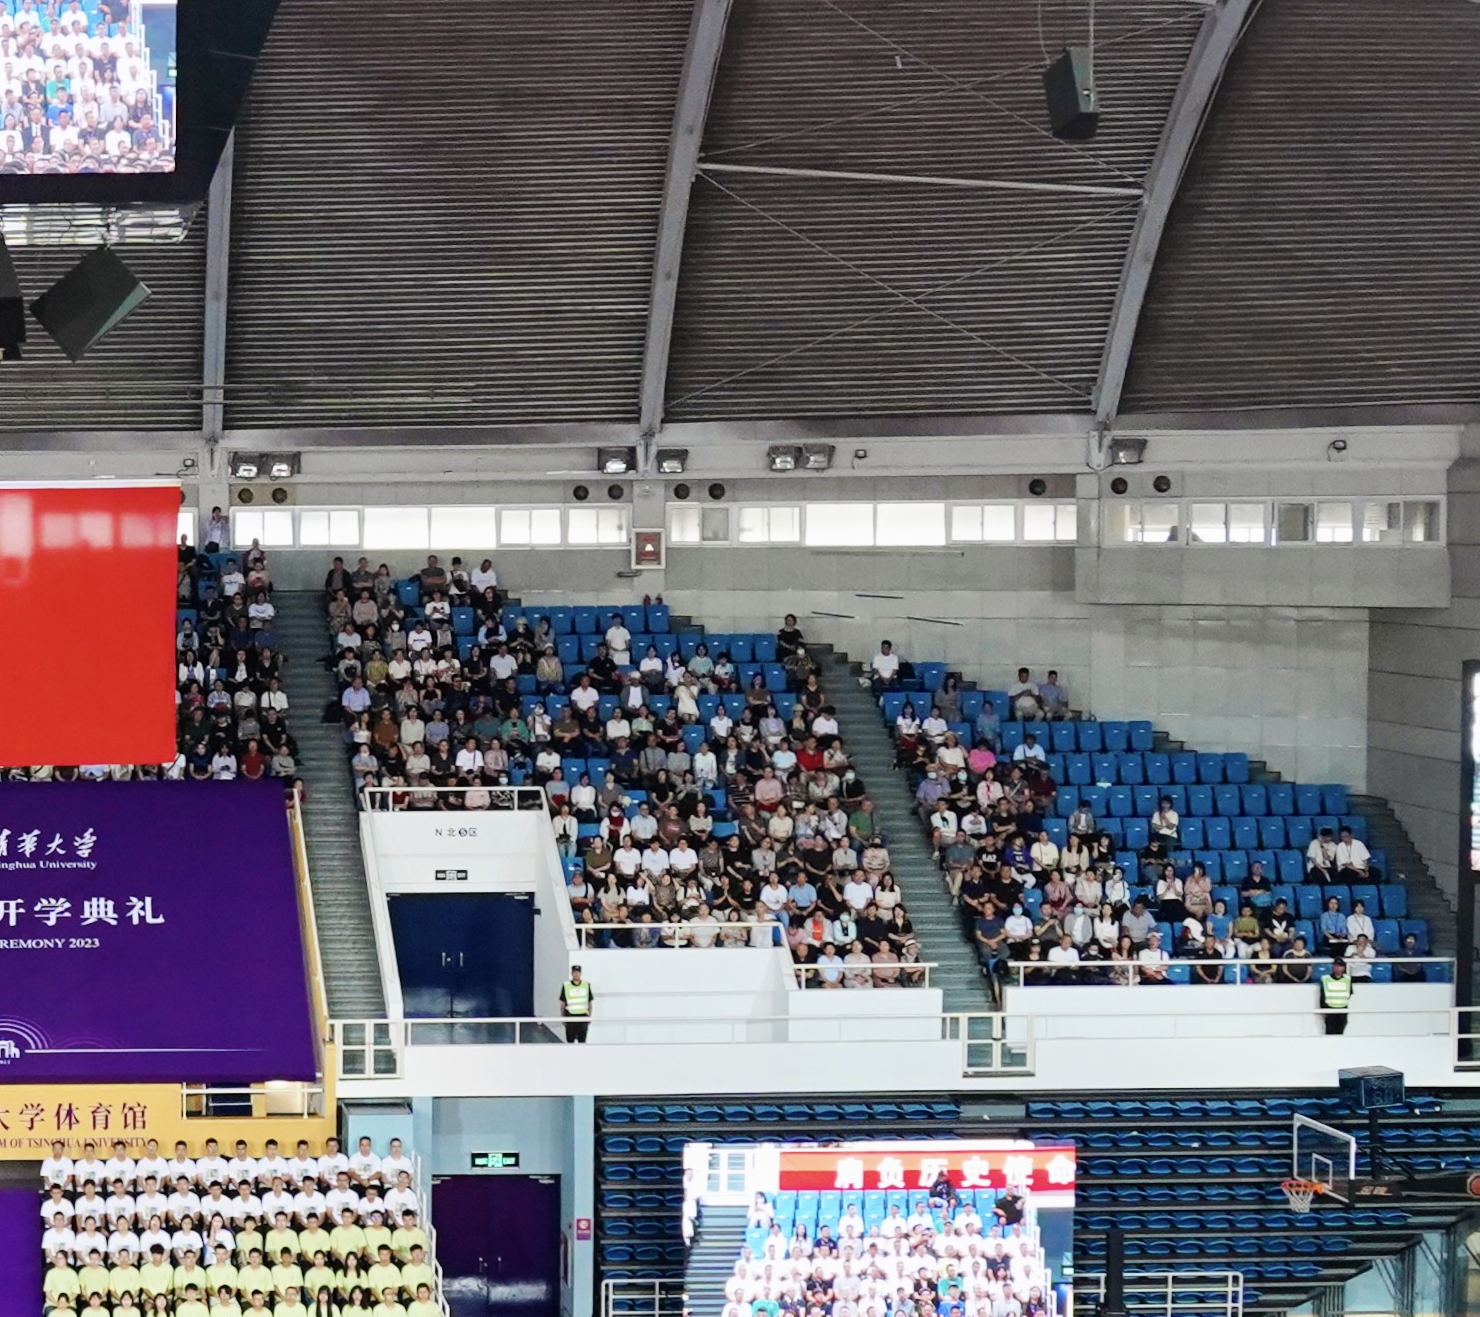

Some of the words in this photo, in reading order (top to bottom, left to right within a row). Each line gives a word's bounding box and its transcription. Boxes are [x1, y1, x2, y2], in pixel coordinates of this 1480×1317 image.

[39, 860, 98, 871] University
[69, 937, 100, 949] 2023
[9, 1137, 24, 1148] OF
